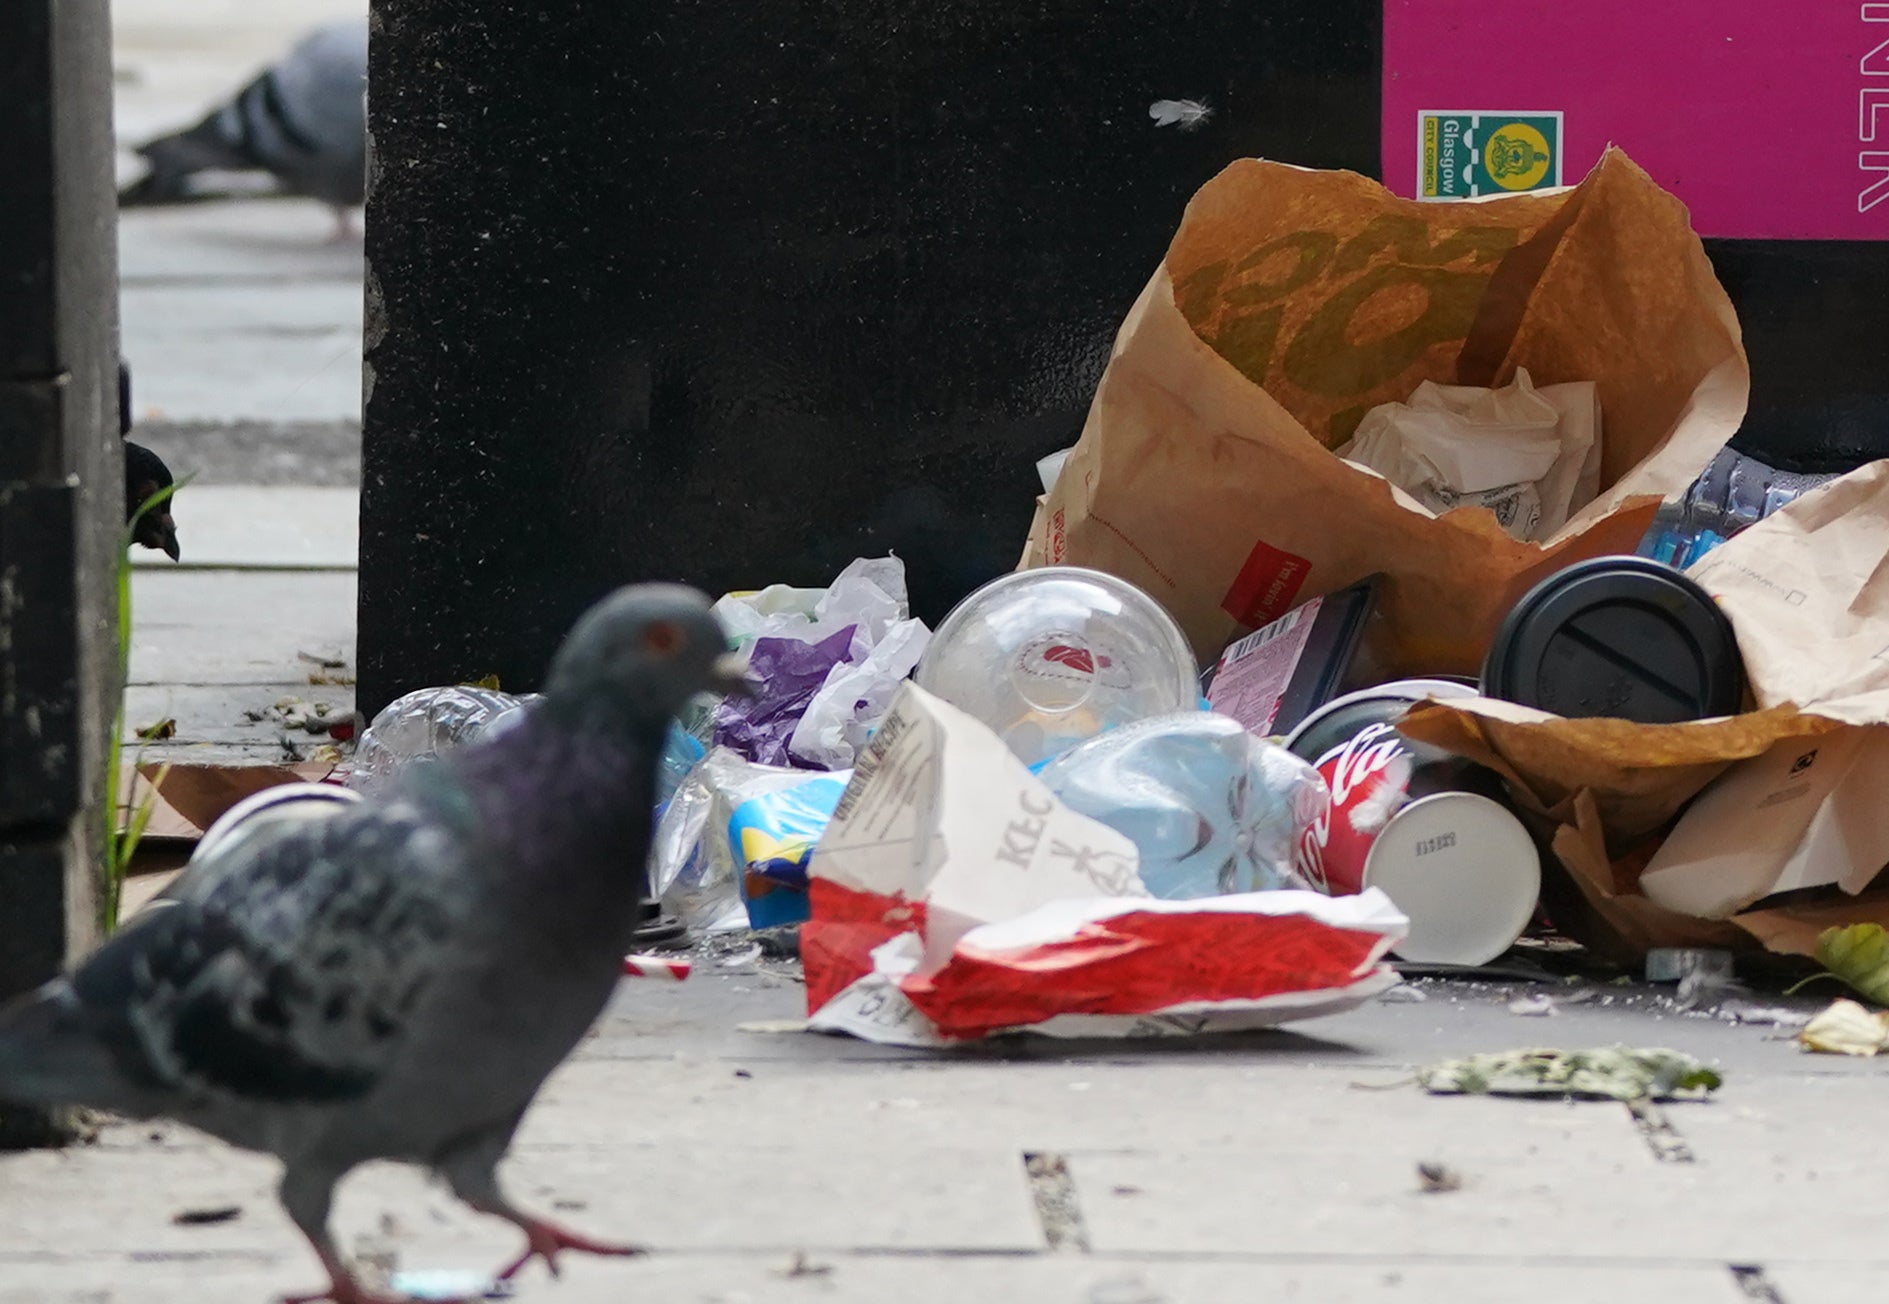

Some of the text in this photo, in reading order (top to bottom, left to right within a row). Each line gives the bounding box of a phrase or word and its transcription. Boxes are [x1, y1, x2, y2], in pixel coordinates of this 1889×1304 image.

[1426, 120, 1434, 143] CITY
[1440, 119, 1459, 194] Glasgow
[995, 788, 1053, 871] KFC
